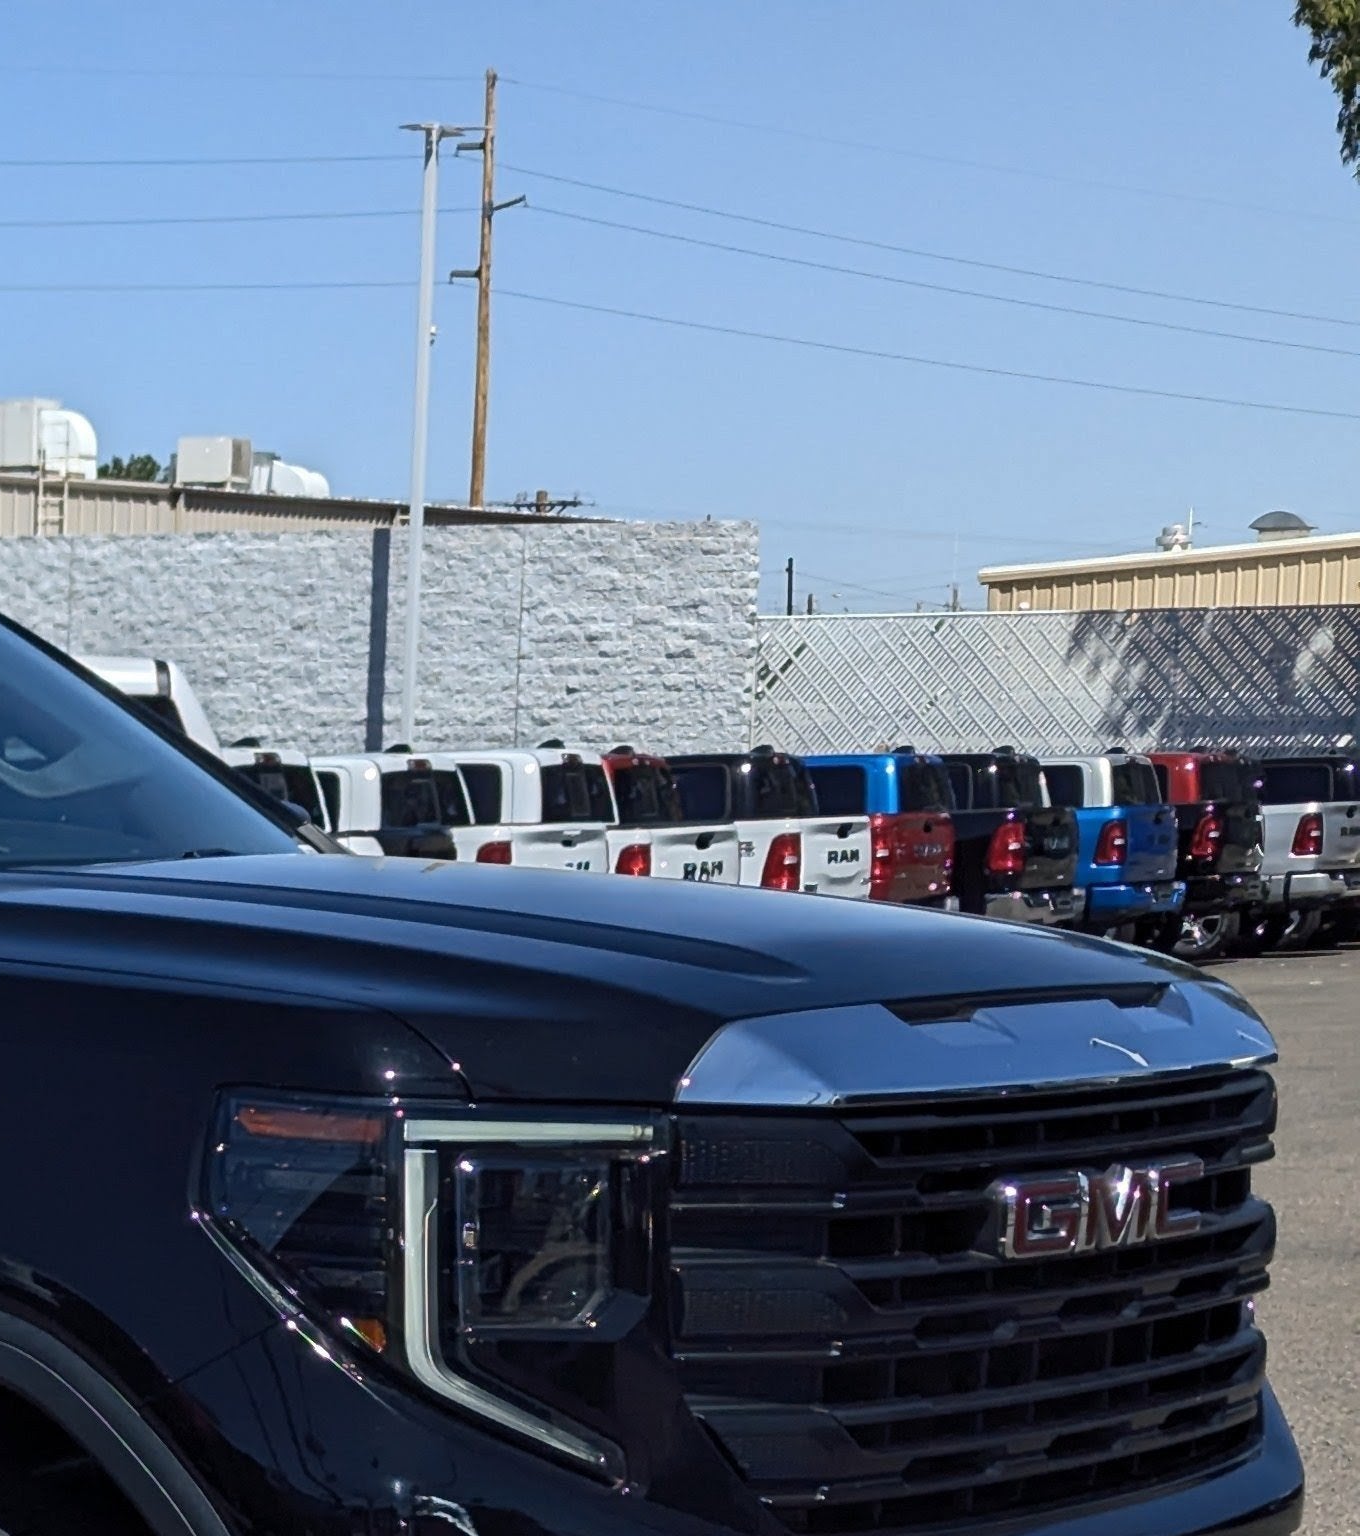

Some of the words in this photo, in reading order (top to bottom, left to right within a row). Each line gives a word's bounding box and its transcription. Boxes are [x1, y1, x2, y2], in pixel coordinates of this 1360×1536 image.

[826, 849, 860, 864] RAM
[682, 861, 724, 882] RAM
[985, 1154, 1205, 1260] GMC
